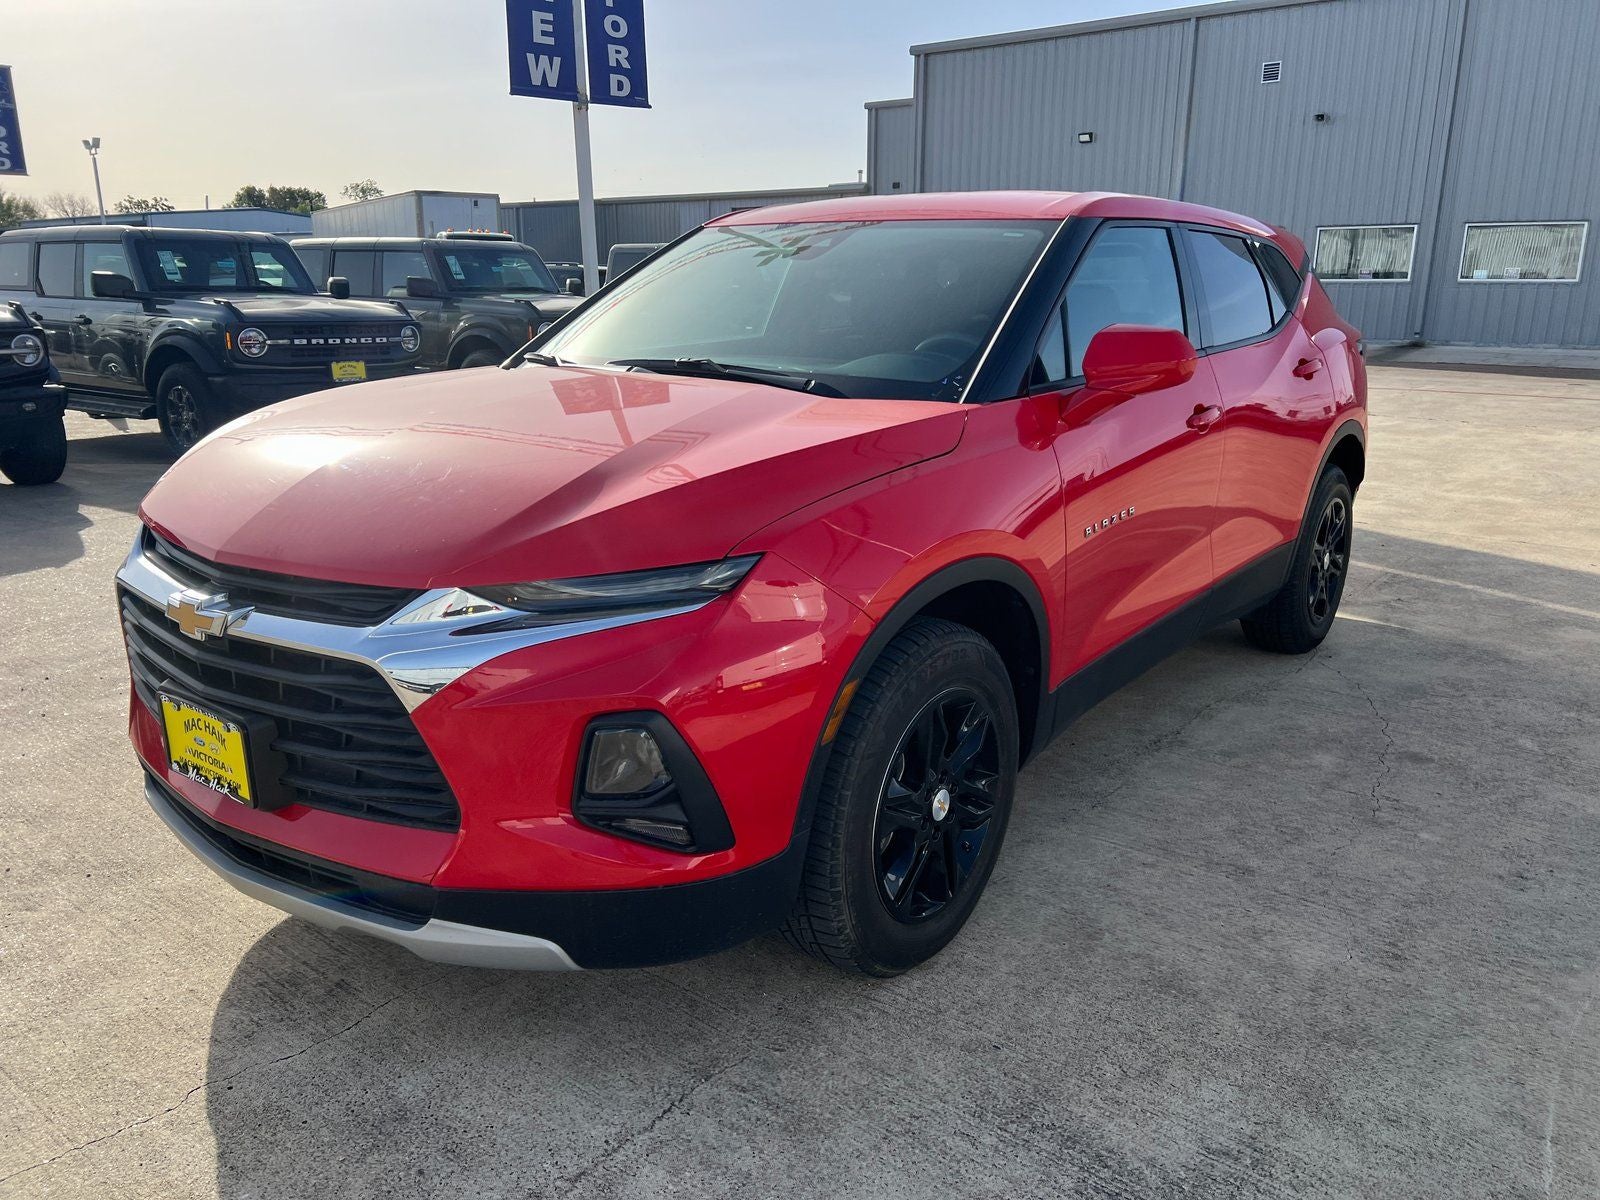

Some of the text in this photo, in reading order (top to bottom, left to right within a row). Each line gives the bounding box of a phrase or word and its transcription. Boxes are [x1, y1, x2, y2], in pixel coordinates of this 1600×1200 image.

[526, 0, 562, 88] EW
[293, 337, 387, 345] BRONCO
[1084, 506, 1135, 538] BLAZER
[184, 718, 202, 733] MAC
[191, 748, 229, 772] VICTORIA
